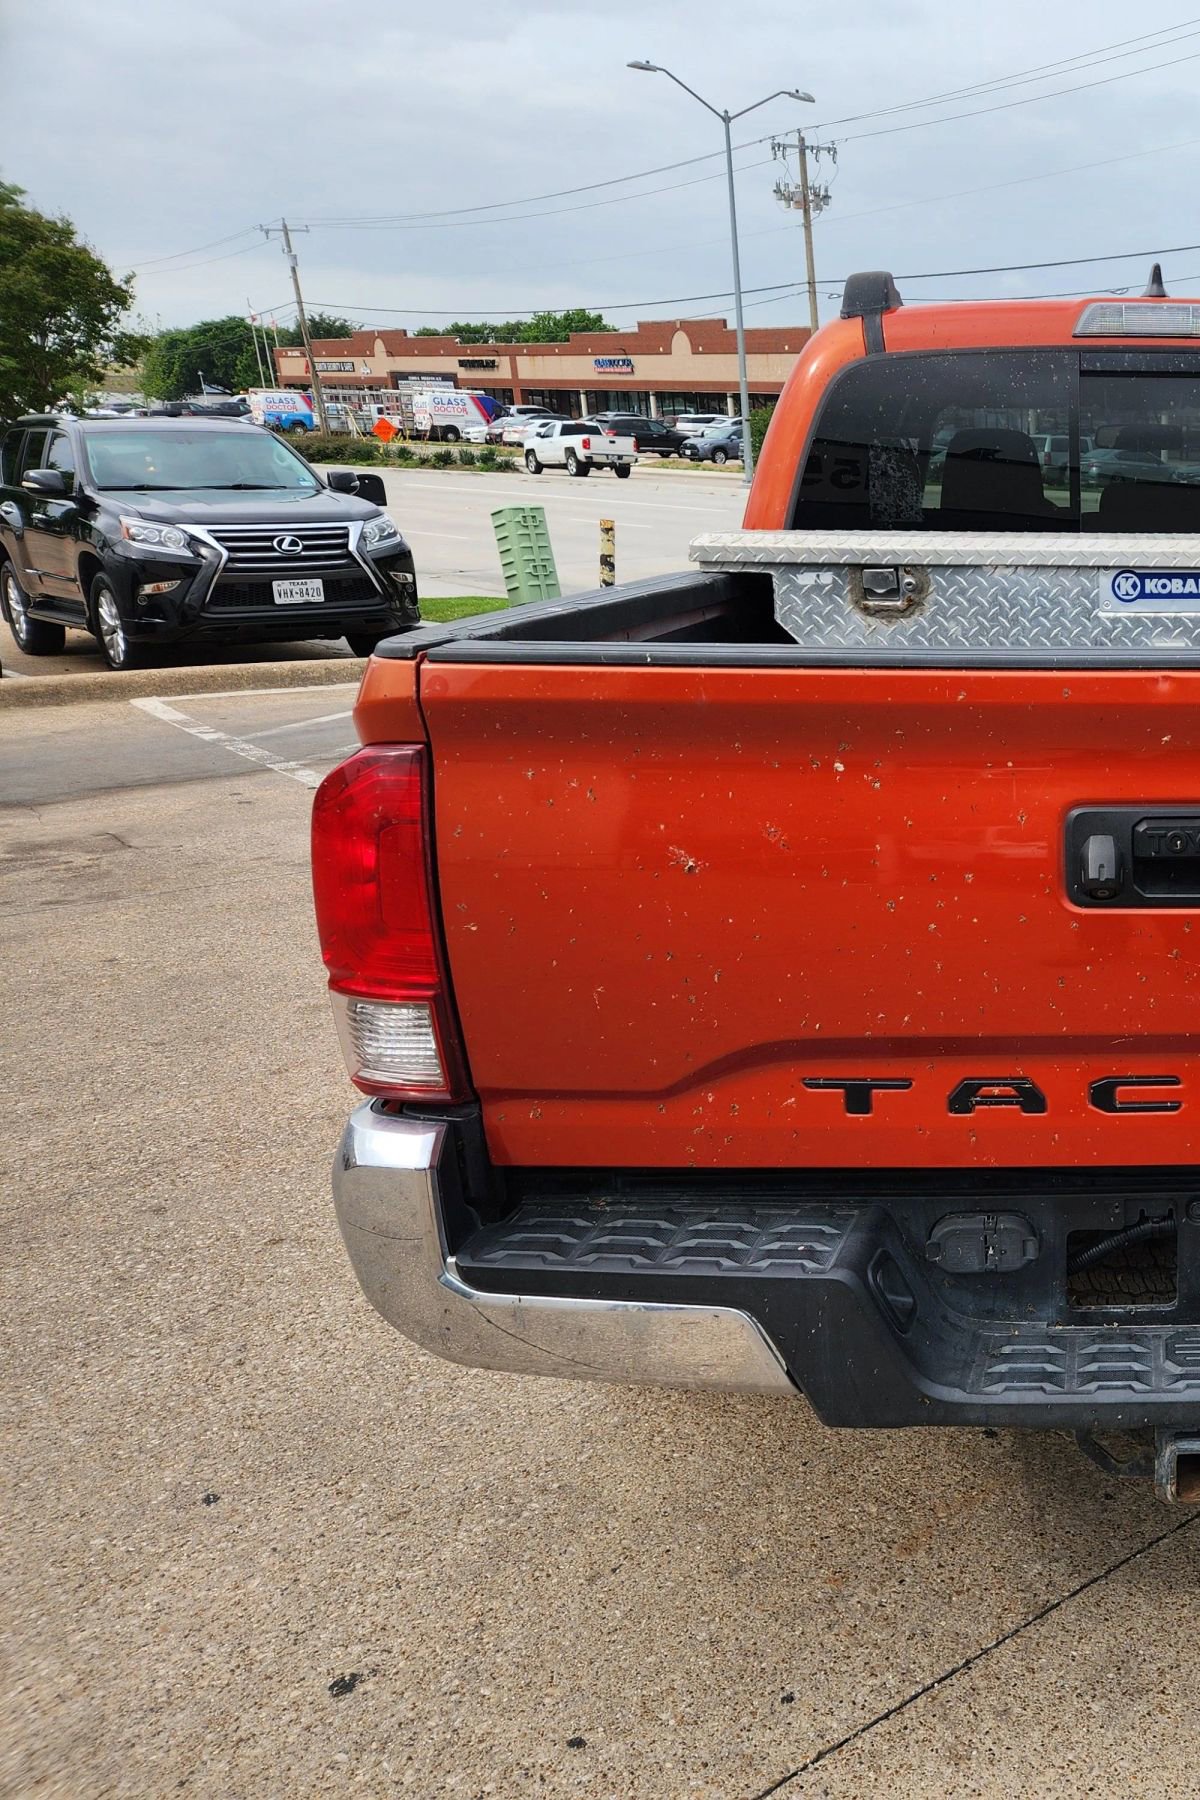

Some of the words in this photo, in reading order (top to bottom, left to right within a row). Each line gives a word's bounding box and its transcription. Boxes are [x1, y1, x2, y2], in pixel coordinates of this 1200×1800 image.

[265, 397, 296, 405] GLASS
[433, 397, 467, 406] GLASS
[434, 406, 468, 415] DOCTOR
